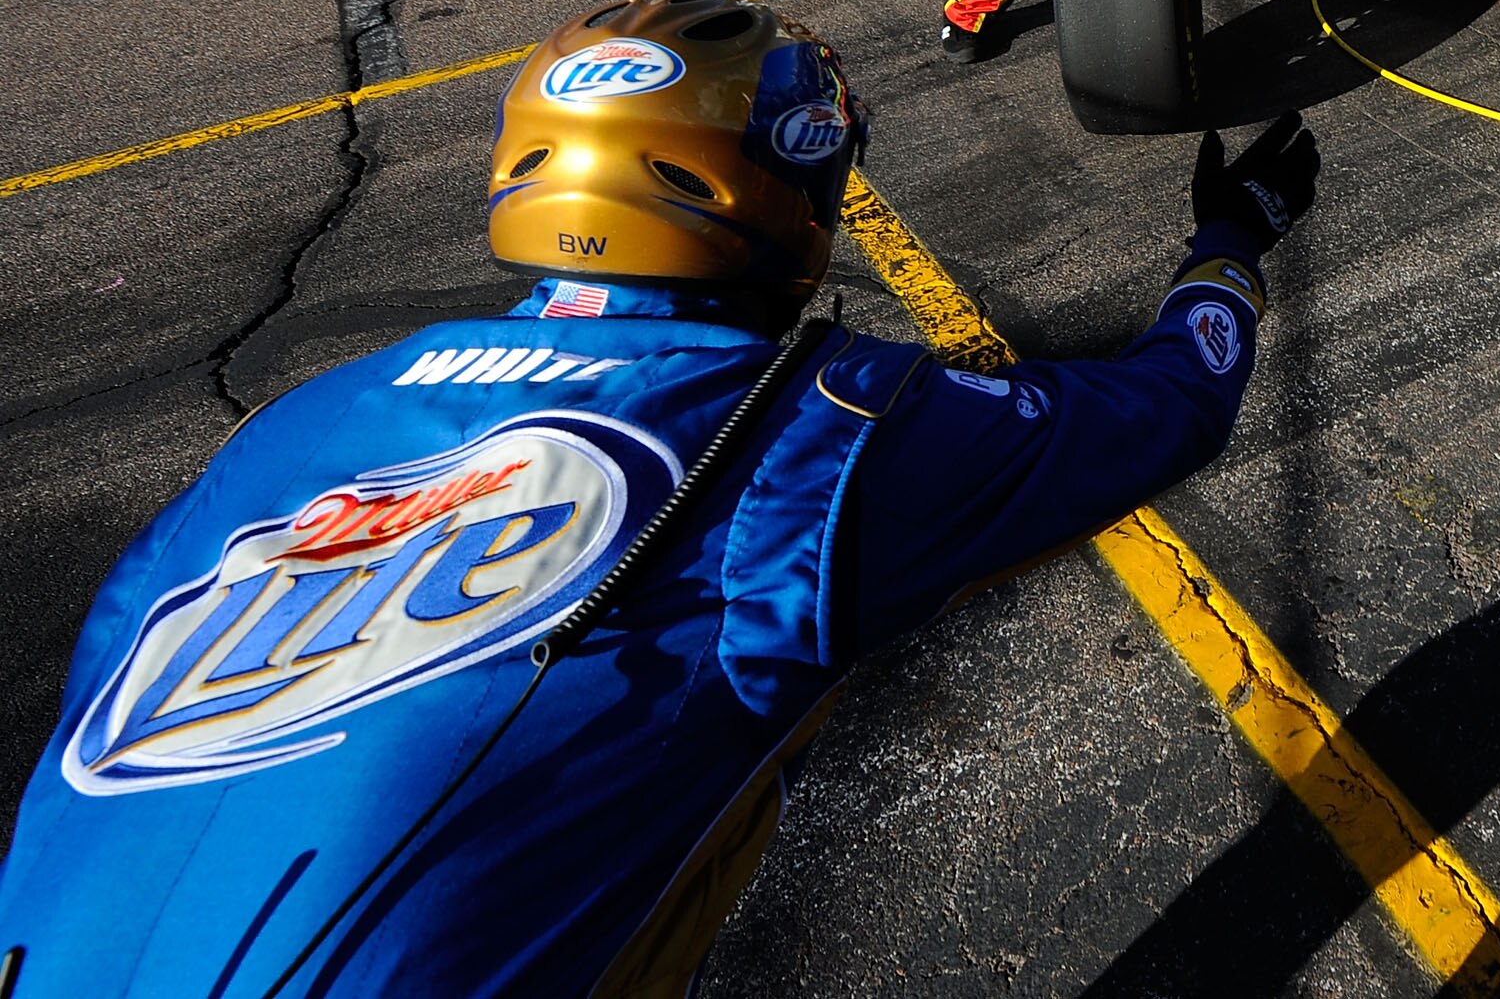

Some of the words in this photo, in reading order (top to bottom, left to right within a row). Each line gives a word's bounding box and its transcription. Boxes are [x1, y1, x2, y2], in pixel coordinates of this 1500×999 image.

[591, 43, 653, 61] Miller
[560, 59, 665, 96] Lite
[785, 119, 846, 153] Lite
[558, 232, 608, 257] BW
[1205, 312, 1229, 369] Lite
[392, 346, 634, 387] WHITE
[287, 459, 533, 560] Miller
[89, 501, 579, 773] Lite
